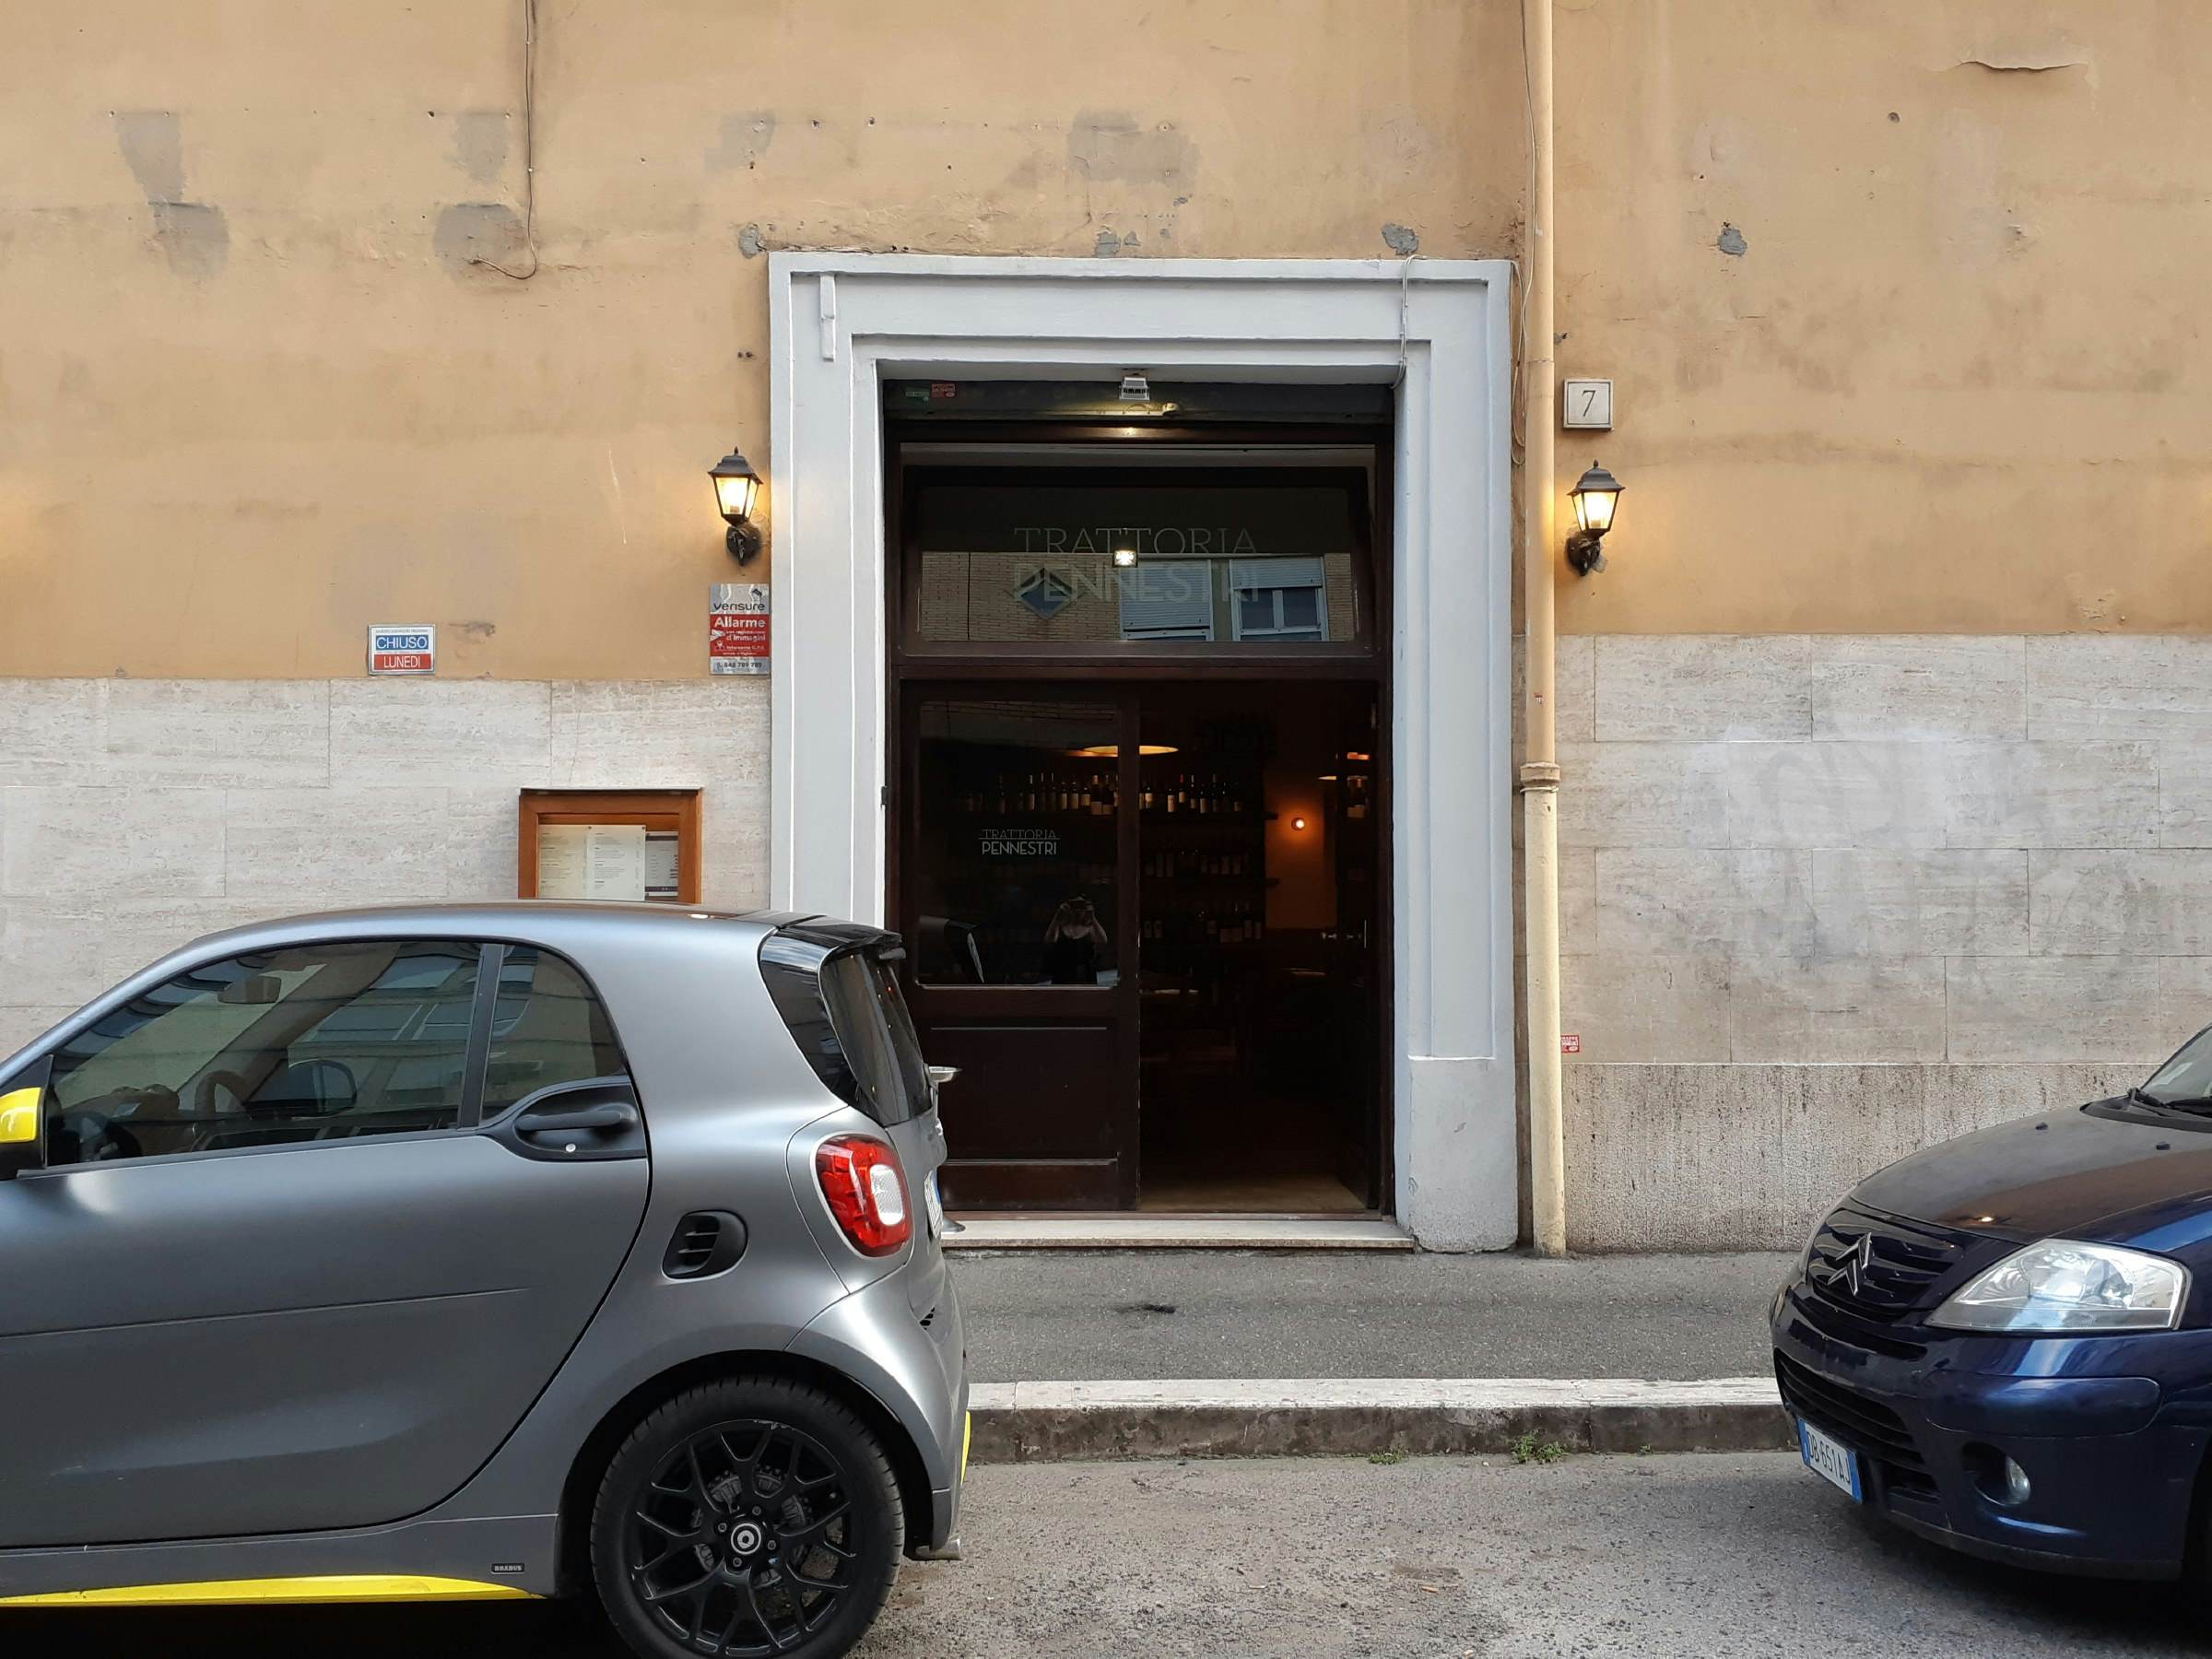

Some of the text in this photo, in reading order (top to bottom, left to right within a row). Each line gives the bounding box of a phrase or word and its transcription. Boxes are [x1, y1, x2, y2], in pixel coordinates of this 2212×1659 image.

[1581, 389, 1596, 418] 7
[1014, 527, 1259, 555] TRATTORIA
[713, 603, 766, 611] verisure
[714, 616, 766, 628] Allarme
[376, 636, 428, 649] CHIUSO
[383, 655, 420, 668] LUNEDI
[982, 829, 1057, 840] TRATTORIA
[982, 841, 1057, 855] PENNESTRI
